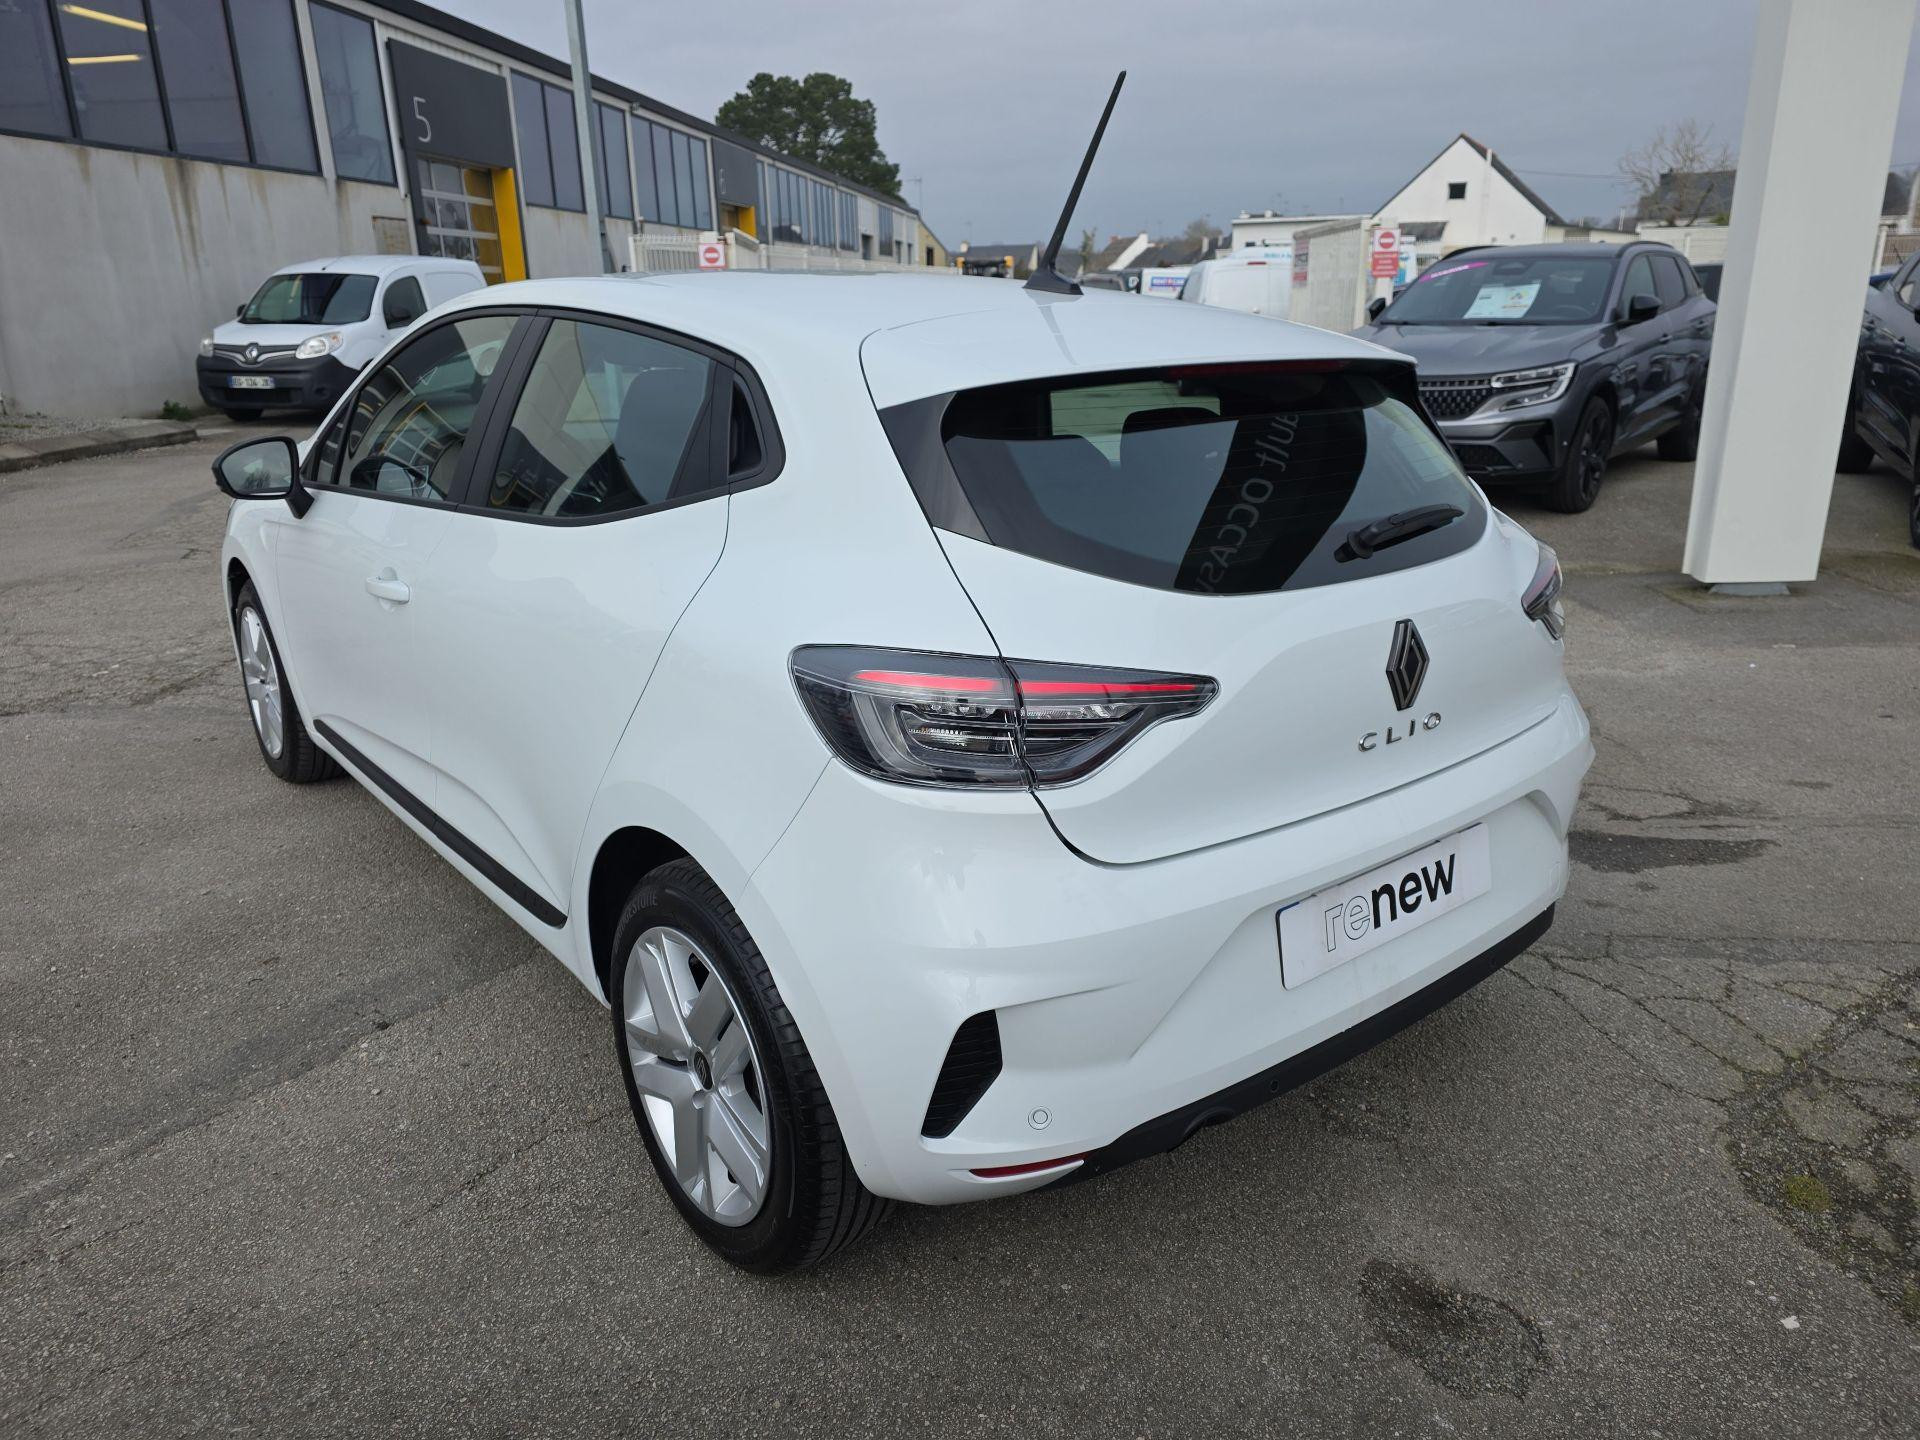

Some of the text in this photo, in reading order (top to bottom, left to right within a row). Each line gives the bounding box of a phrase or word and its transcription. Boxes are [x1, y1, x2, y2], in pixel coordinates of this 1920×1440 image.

[413, 96, 431, 143] 5
[1358, 711, 1442, 752] CLIO
[1324, 853, 1456, 952] renew
